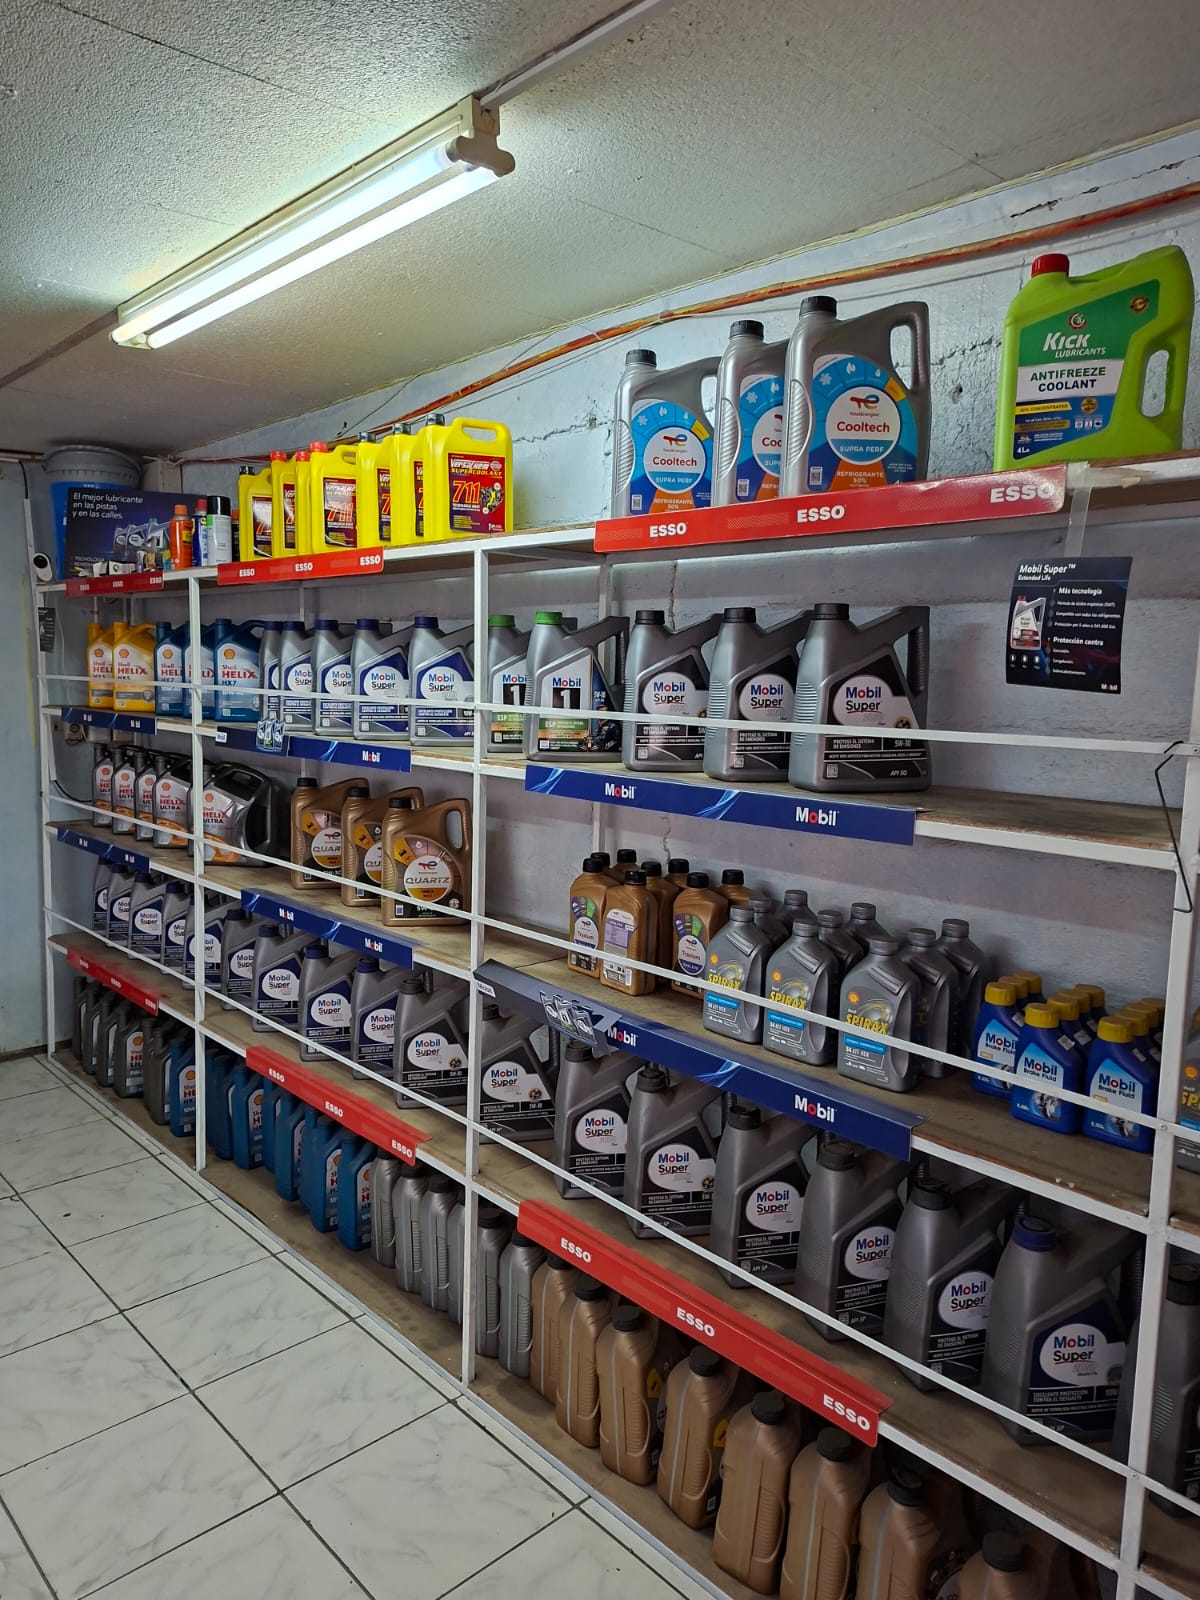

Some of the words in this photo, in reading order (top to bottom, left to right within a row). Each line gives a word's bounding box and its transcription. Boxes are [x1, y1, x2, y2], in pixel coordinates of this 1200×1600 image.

[1055, 347, 1106, 358] LUBRICANTS
[1030, 366, 1106, 382] ANTIFREEZE
[1038, 379, 1097, 392] COOLANT
[836, 421, 890, 433] Cooltech
[652, 456, 697, 467] Cooltech
[451, 468, 503, 477] SUPERCOOLANT
[73, 492, 81, 500] El
[82, 494, 105, 503] mejor
[106, 494, 144, 504] lubricante
[452, 480, 480, 504] 711
[990, 482, 1055, 504] ESSO
[96, 503, 118, 512] pistas
[327, 503, 354, 522] 711
[72, 510, 78, 518] y
[90, 510, 100, 518] las
[797, 505, 846, 523] ESSO
[650, 522, 687, 538] ESSO
[360, 555, 381, 566] ESSO
[239, 569, 255, 577] ESSO
[295, 562, 313, 572] ESSO
[1020, 564, 1042, 574] Mobil
[1072, 588, 1102, 596] tecnología
[1053, 636, 1084, 645] Protección
[1084, 638, 1104, 646] contra
[118, 667, 148, 675] HELIX
[222, 670, 255, 679] HELIX
[294, 670, 312, 678] Mob
[332, 671, 352, 680] Mob
[372, 672, 396, 681] Mobil
[428, 674, 455, 683] Mobil
[552, 678, 582, 688] Mobil
[372, 681, 396, 690] Super
[429, 682, 454, 692] Super
[654, 682, 686, 692] Mobil
[750, 684, 784, 696] Mobil
[510, 686, 520, 706] 1
[654, 693, 685, 704] Super
[846, 686, 882, 699] Mobil
[560, 690, 570, 708] 1
[750, 696, 783, 708] Super
[846, 700, 881, 713] Super
[362, 750, 380, 762] Mobil
[605, 782, 635, 800] Mobil
[160, 798, 185, 806] HELIX
[203, 811, 228, 819] HELIX
[796, 806, 837, 826] Mobil
[279, 908, 294, 921] Mobil
[365, 938, 383, 952] Mobil
[708, 973, 741, 990] SPIRAX
[318, 999, 341, 1007] Mobil
[769, 991, 806, 1010] SPIRAX
[318, 1007, 341, 1015] Super
[370, 1014, 395, 1023] Mobil
[846, 1014, 888, 1034] SPIRAX
[371, 1023, 394, 1032] Super
[415, 1038, 440, 1048] Mobil
[607, 1026, 638, 1048] Mobil
[986, 1032, 1017, 1049] Mobil
[985, 1042, 1000, 1051] Brake
[415, 1048, 440, 1058] Super
[1024, 1056, 1057, 1076] Mobil
[269, 1068, 285, 1083] ESSO
[491, 1069, 518, 1078] Mobil
[1024, 1069, 1040, 1078] Brake
[1041, 1073, 1057, 1082] Fluid
[491, 1078, 517, 1088] Super
[1100, 1074, 1136, 1093] Mobil
[1098, 1085, 1116, 1094] Brake
[1119, 1089, 1135, 1099] Fluid
[325, 1101, 343, 1118] ESSO
[794, 1094, 835, 1123] Mobil
[585, 1118, 615, 1127] Mobil
[585, 1128, 614, 1138] Super
[391, 1139, 413, 1158] ESSO
[658, 1152, 689, 1164] Mobil
[658, 1164, 689, 1175] Super
[756, 1190, 789, 1202] Mobil
[756, 1203, 789, 1214] Super
[856, 1235, 889, 1250] Mobil
[560, 1237, 592, 1263] ESSO
[856, 1249, 889, 1262] Super
[951, 1281, 987, 1298] Mobil
[950, 1295, 986, 1310] Super
[676, 1306, 715, 1338] ESSO
[1054, 1334, 1095, 1350] Mobil
[1053, 1350, 1094, 1363] Super
[822, 1393, 871, 1431] ESSO
